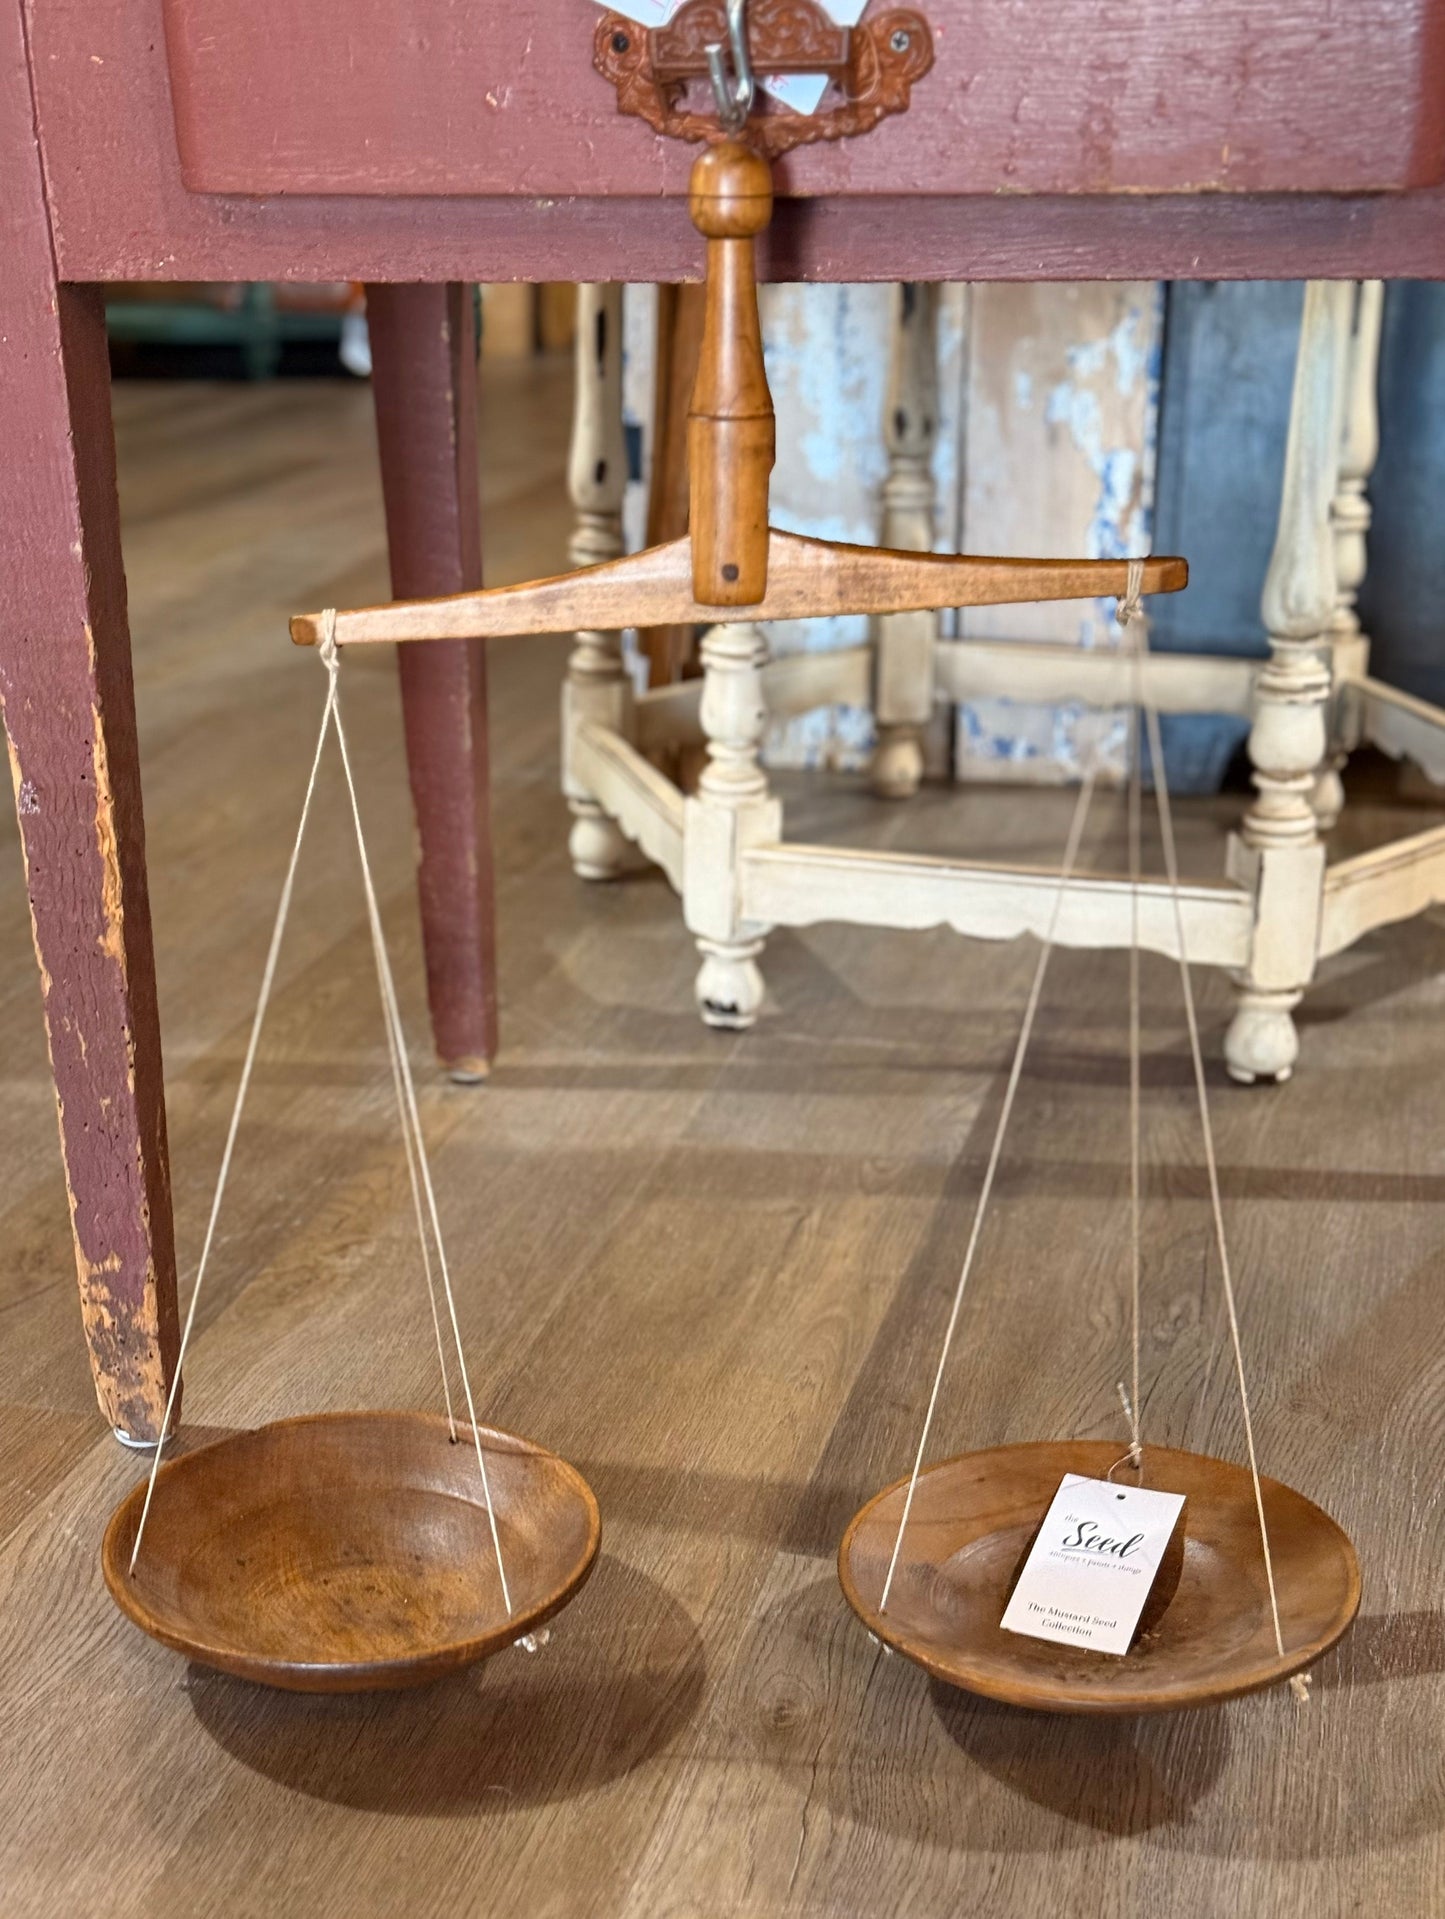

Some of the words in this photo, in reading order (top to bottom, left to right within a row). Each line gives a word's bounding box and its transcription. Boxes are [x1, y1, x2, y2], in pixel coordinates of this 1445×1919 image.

[1062, 1521, 1144, 1557] Seed
[1028, 1602, 1046, 1613] The
[1048, 1606, 1091, 1623] Mustard
[1092, 1616, 1118, 1629] Seed
[1041, 1619, 1092, 1637] Collection
